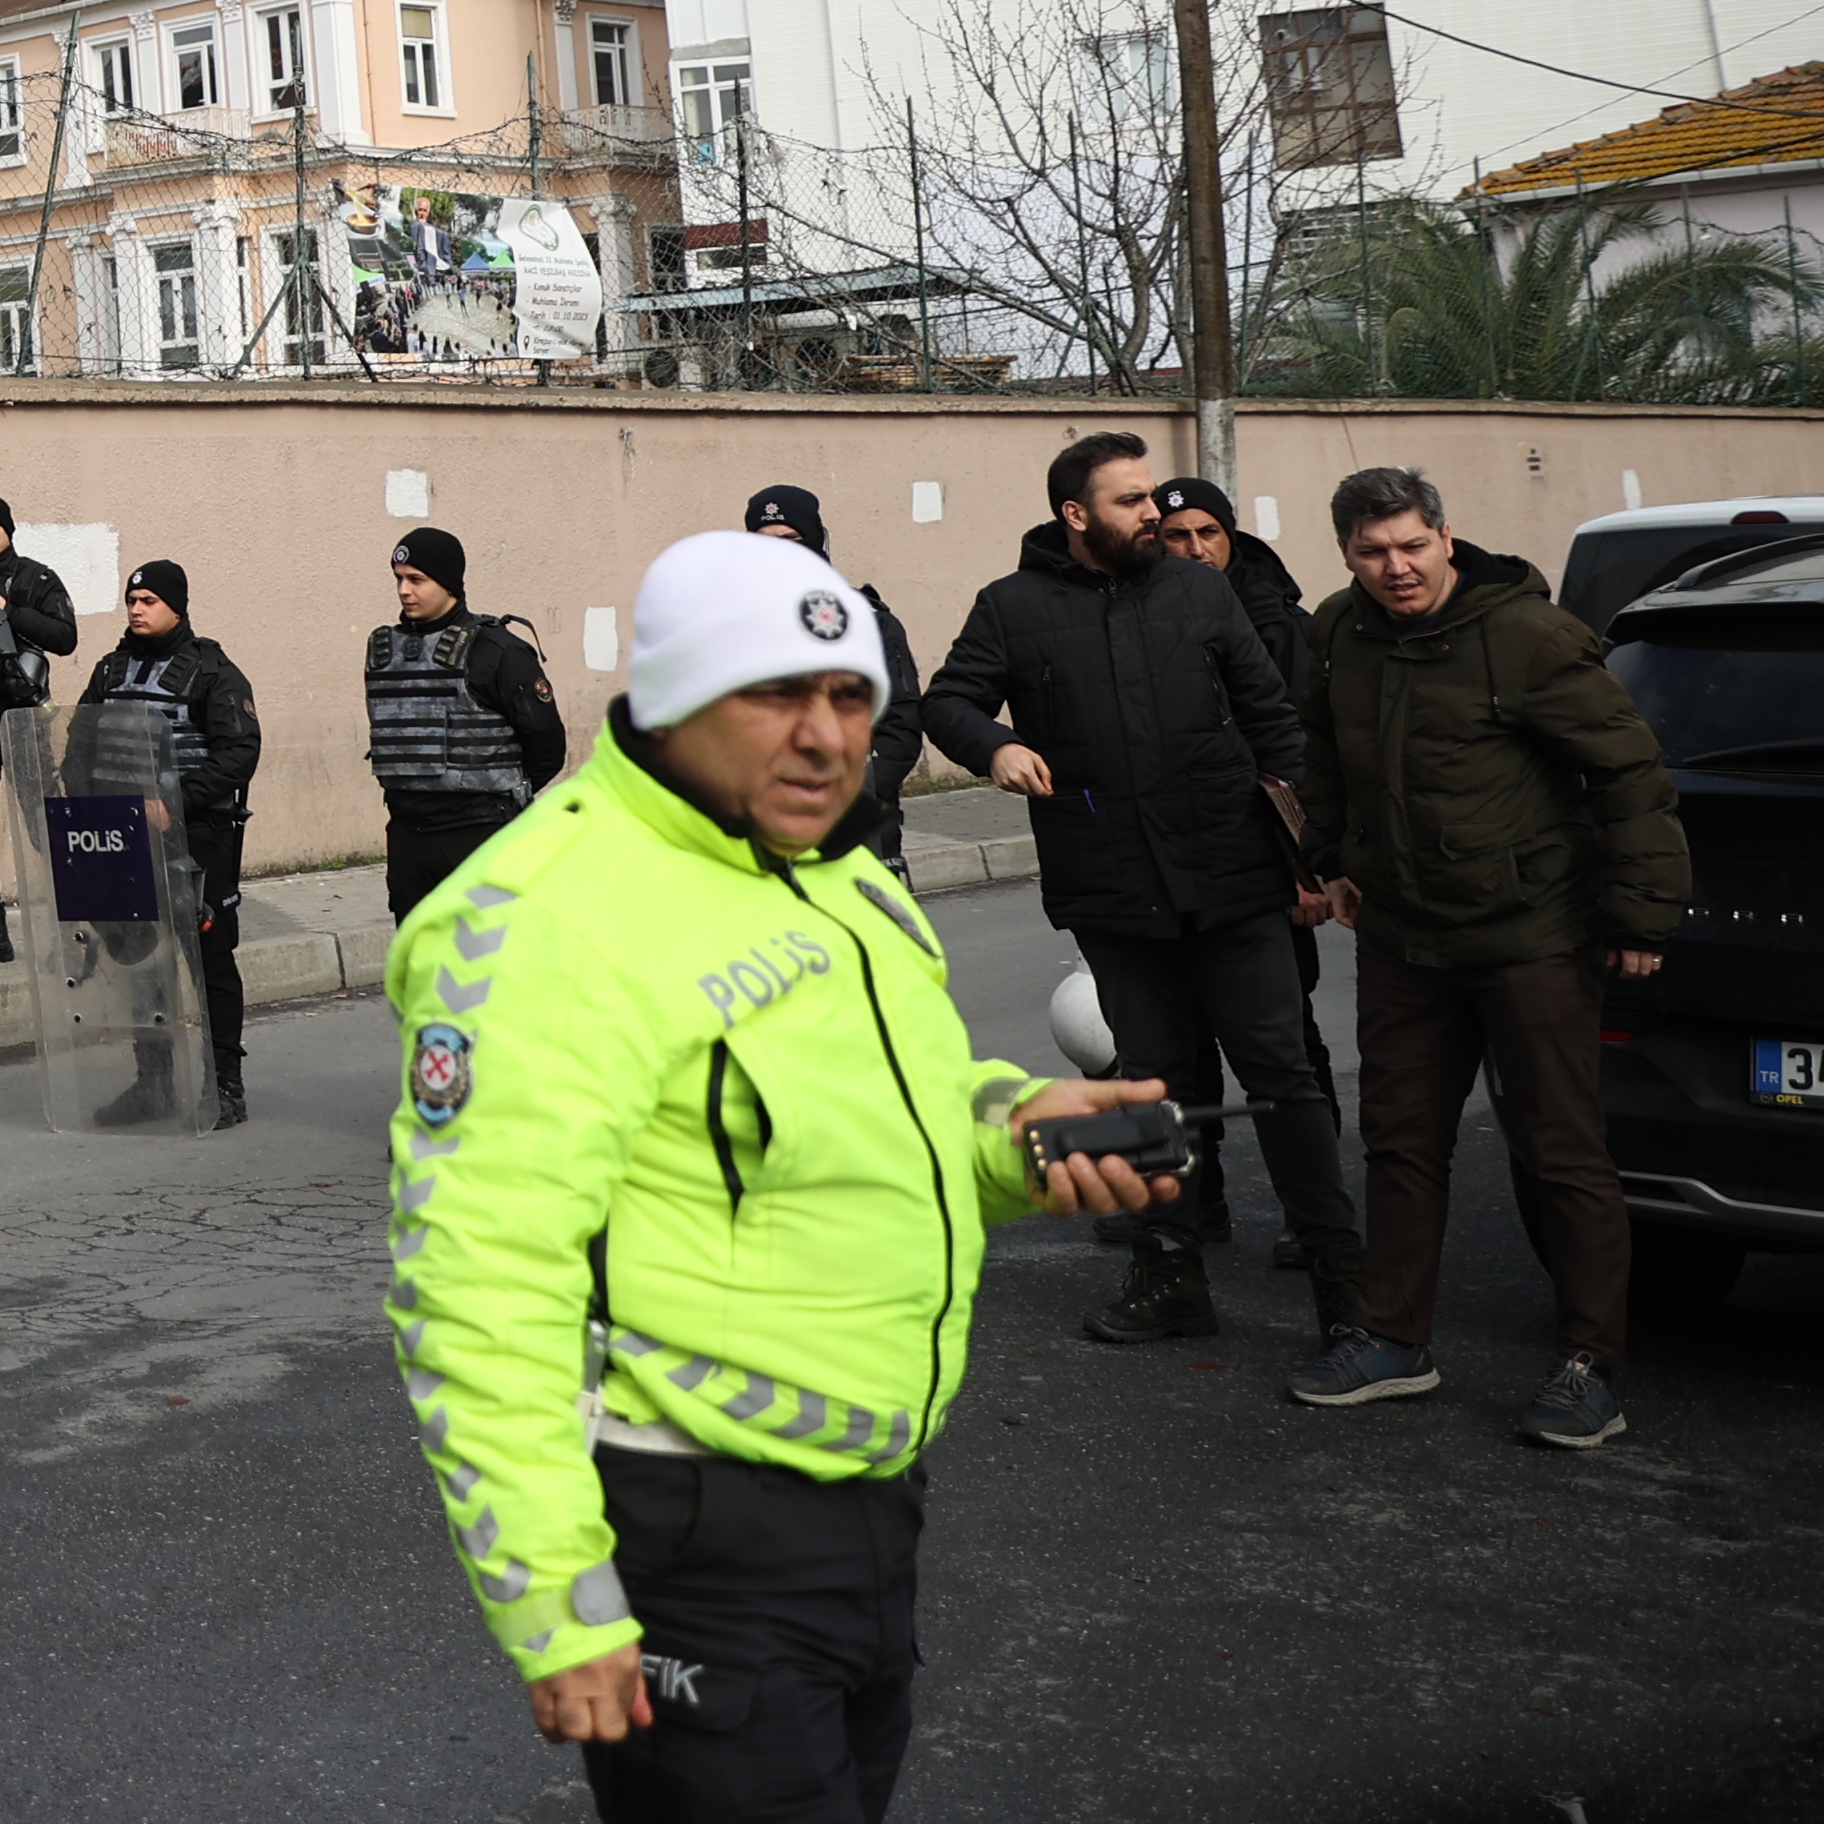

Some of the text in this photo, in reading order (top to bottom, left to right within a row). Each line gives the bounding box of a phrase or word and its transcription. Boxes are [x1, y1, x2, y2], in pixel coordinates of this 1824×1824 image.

[1759, 1047, 1824, 1090] TR 3
[1776, 1094, 1804, 1104] OPEL
